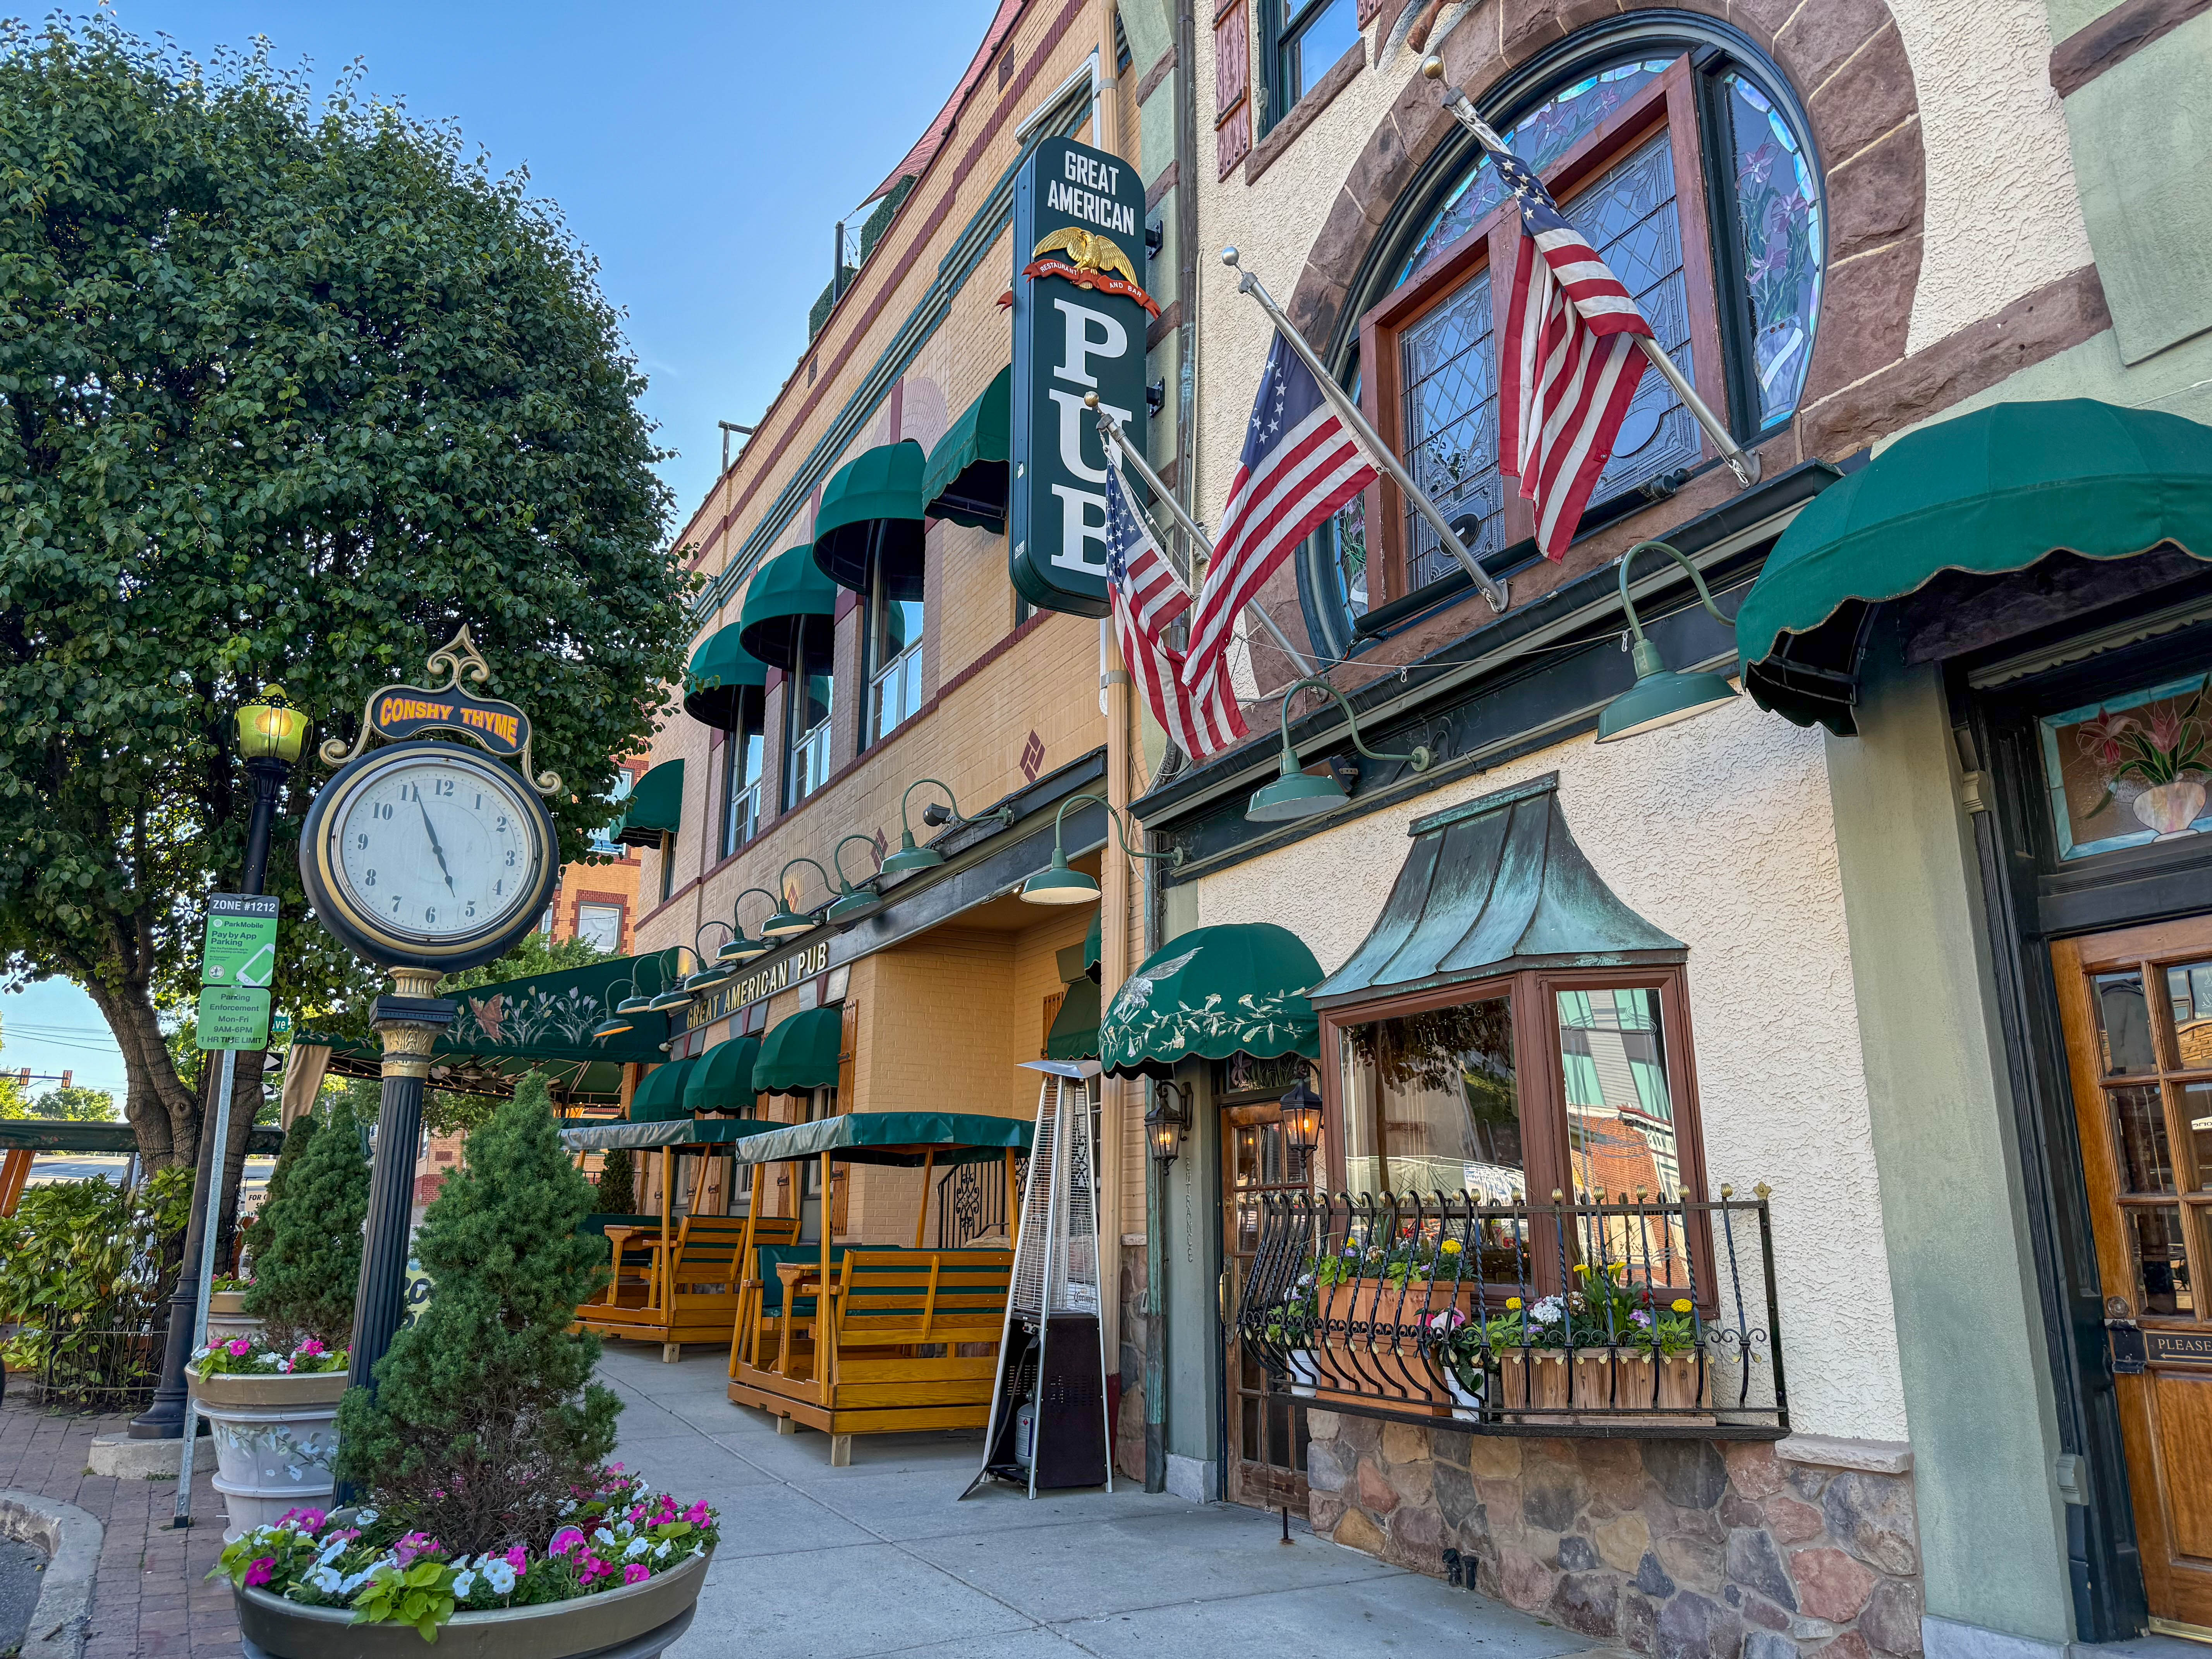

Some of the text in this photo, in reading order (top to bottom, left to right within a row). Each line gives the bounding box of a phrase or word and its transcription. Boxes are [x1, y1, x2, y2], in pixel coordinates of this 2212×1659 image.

[1065, 150, 1119, 196] GREAT
[1048, 180, 1134, 236] AMERICAN
[1040, 261, 1078, 276] RESTAURANT
[1128, 285, 1142, 297] BAR
[1049, 298, 1132, 577] PUB
[380, 697, 519, 748] CONSHY THYME
[400, 784, 418, 802] 11
[434, 779, 454, 797] 12
[474, 793, 481, 810] 1
[373, 802, 393, 820] 10
[496, 816, 507, 833] 2
[357, 833, 368, 850] 9
[506, 850, 515, 867] 3
[365, 869, 376, 886] 8
[492, 879, 502, 895] 4
[213, 900, 275, 912] ZONE #1212
[392, 895, 403, 913] 7
[464, 900, 476, 917] 5
[425, 906, 436, 923] 6
[211, 938, 242, 946] Parking
[229, 931, 239, 939] by
[687, 941, 829, 1030] GREAT AMERICAN PUB
[221, 994, 250, 1002] Parking
[2157, 1338, 2212, 1352] PLEASE
